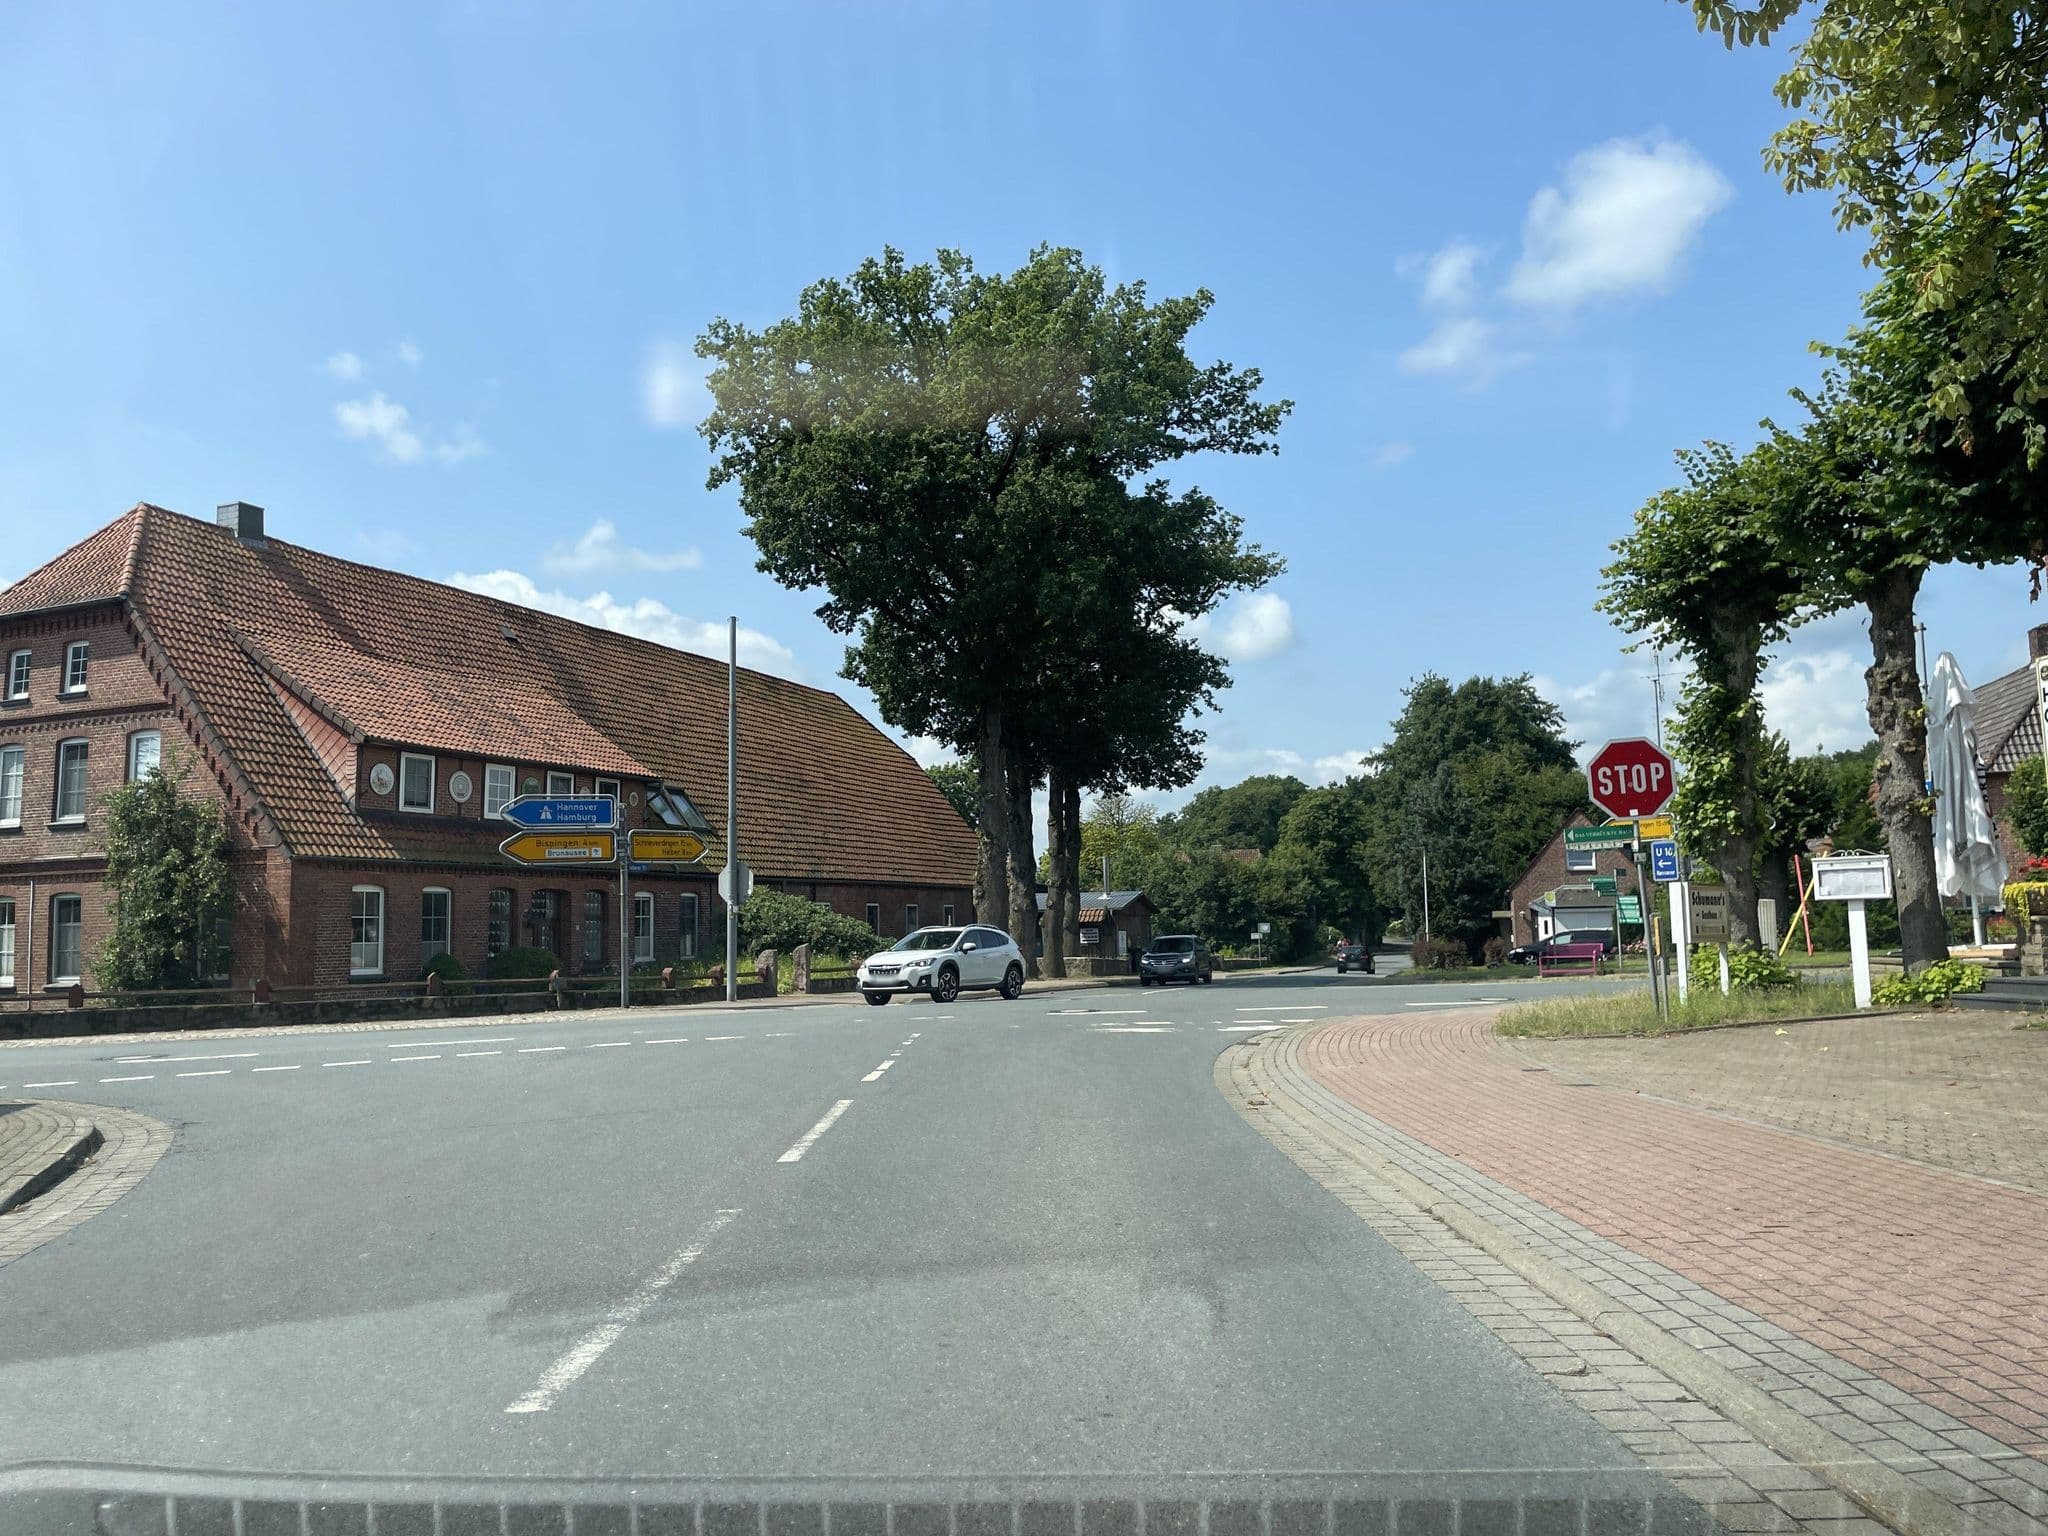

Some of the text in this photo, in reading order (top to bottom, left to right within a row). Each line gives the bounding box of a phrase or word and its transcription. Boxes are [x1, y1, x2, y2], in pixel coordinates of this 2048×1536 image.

[1598, 762, 1665, 796] STOP
[557, 803, 597, 811] Hannover
[557, 813, 597, 823] Hamburg
[536, 839, 579, 849] Bispingen
[547, 849, 587, 857] Brunausee
[1655, 847, 1663, 857] U
